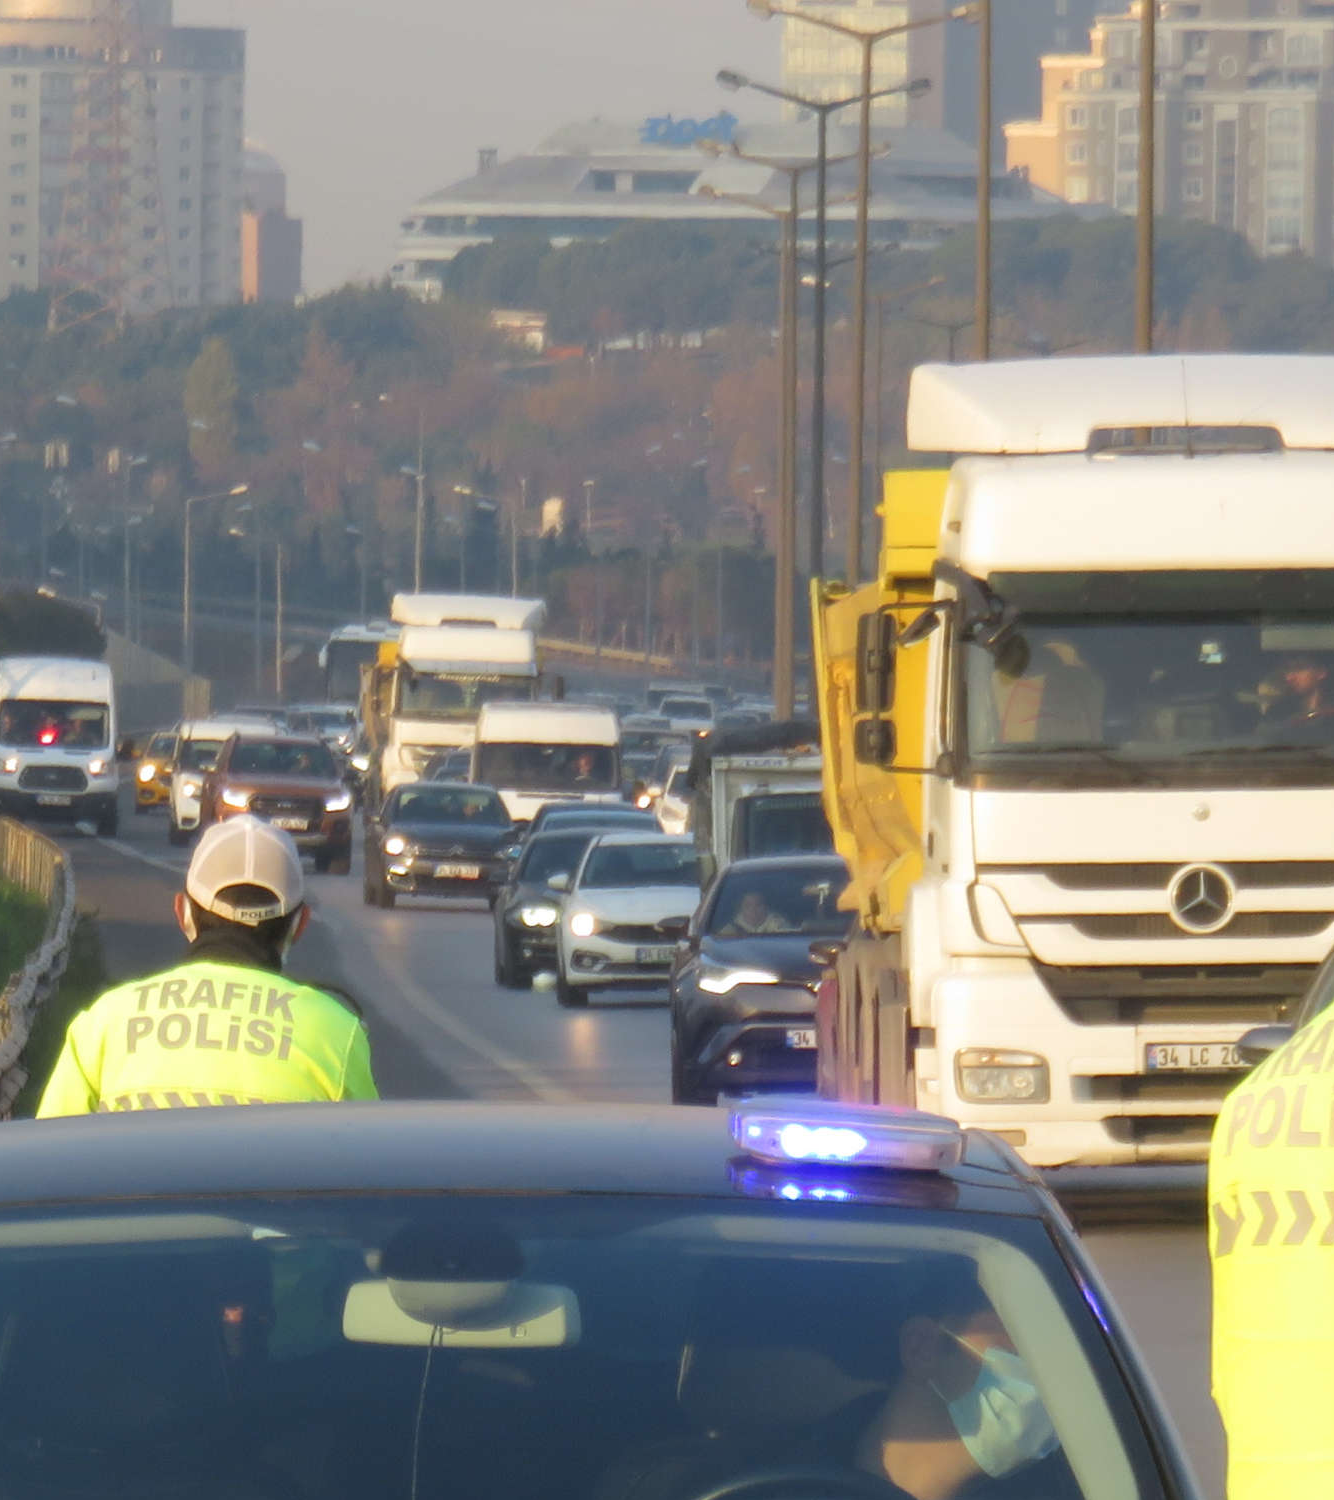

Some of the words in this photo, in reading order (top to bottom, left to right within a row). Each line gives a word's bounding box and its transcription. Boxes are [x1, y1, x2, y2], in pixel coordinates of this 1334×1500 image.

[1157, 1047, 1180, 1067] 34
[1189, 1047, 1210, 1067] LC
[1220, 1046, 1242, 1066] 20
